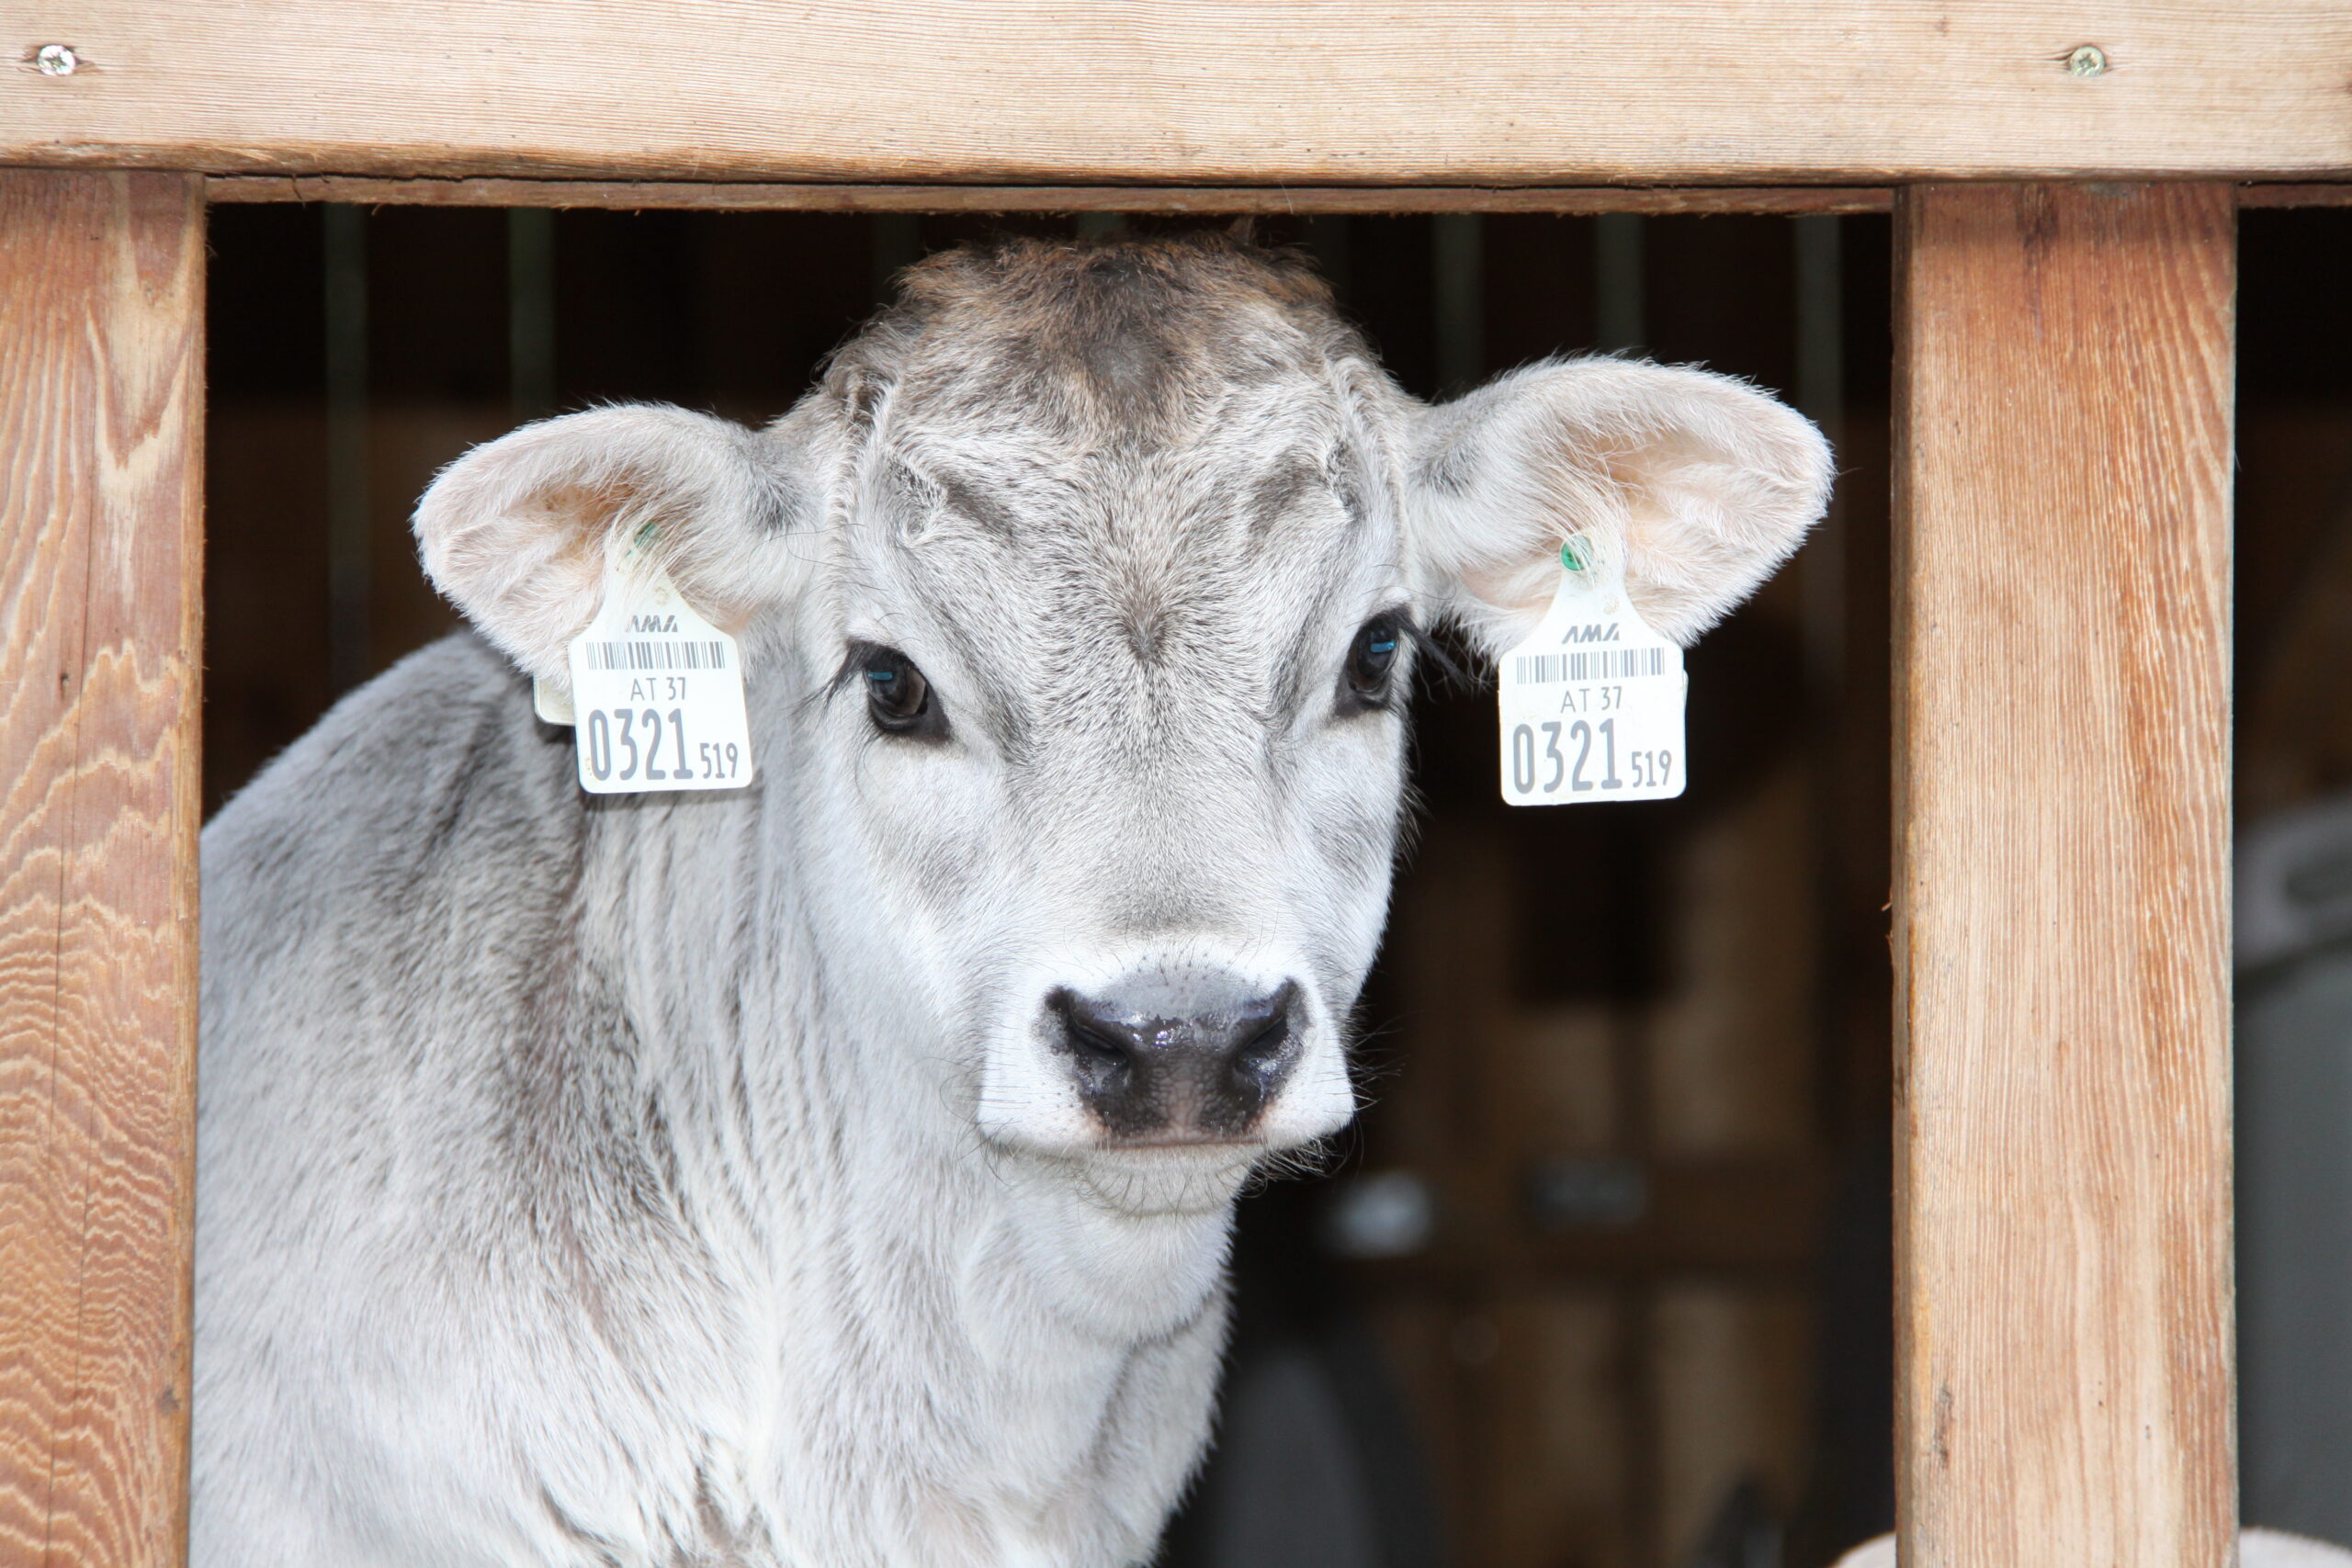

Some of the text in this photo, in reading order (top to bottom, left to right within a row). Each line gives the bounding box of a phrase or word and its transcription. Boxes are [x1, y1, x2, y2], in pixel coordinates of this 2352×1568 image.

[630, 677, 686, 701] AT 37
[1560, 685, 1623, 713] AT 37
[588, 708, 739, 781] 0321 519
[1512, 717, 1672, 795] 0321 519
